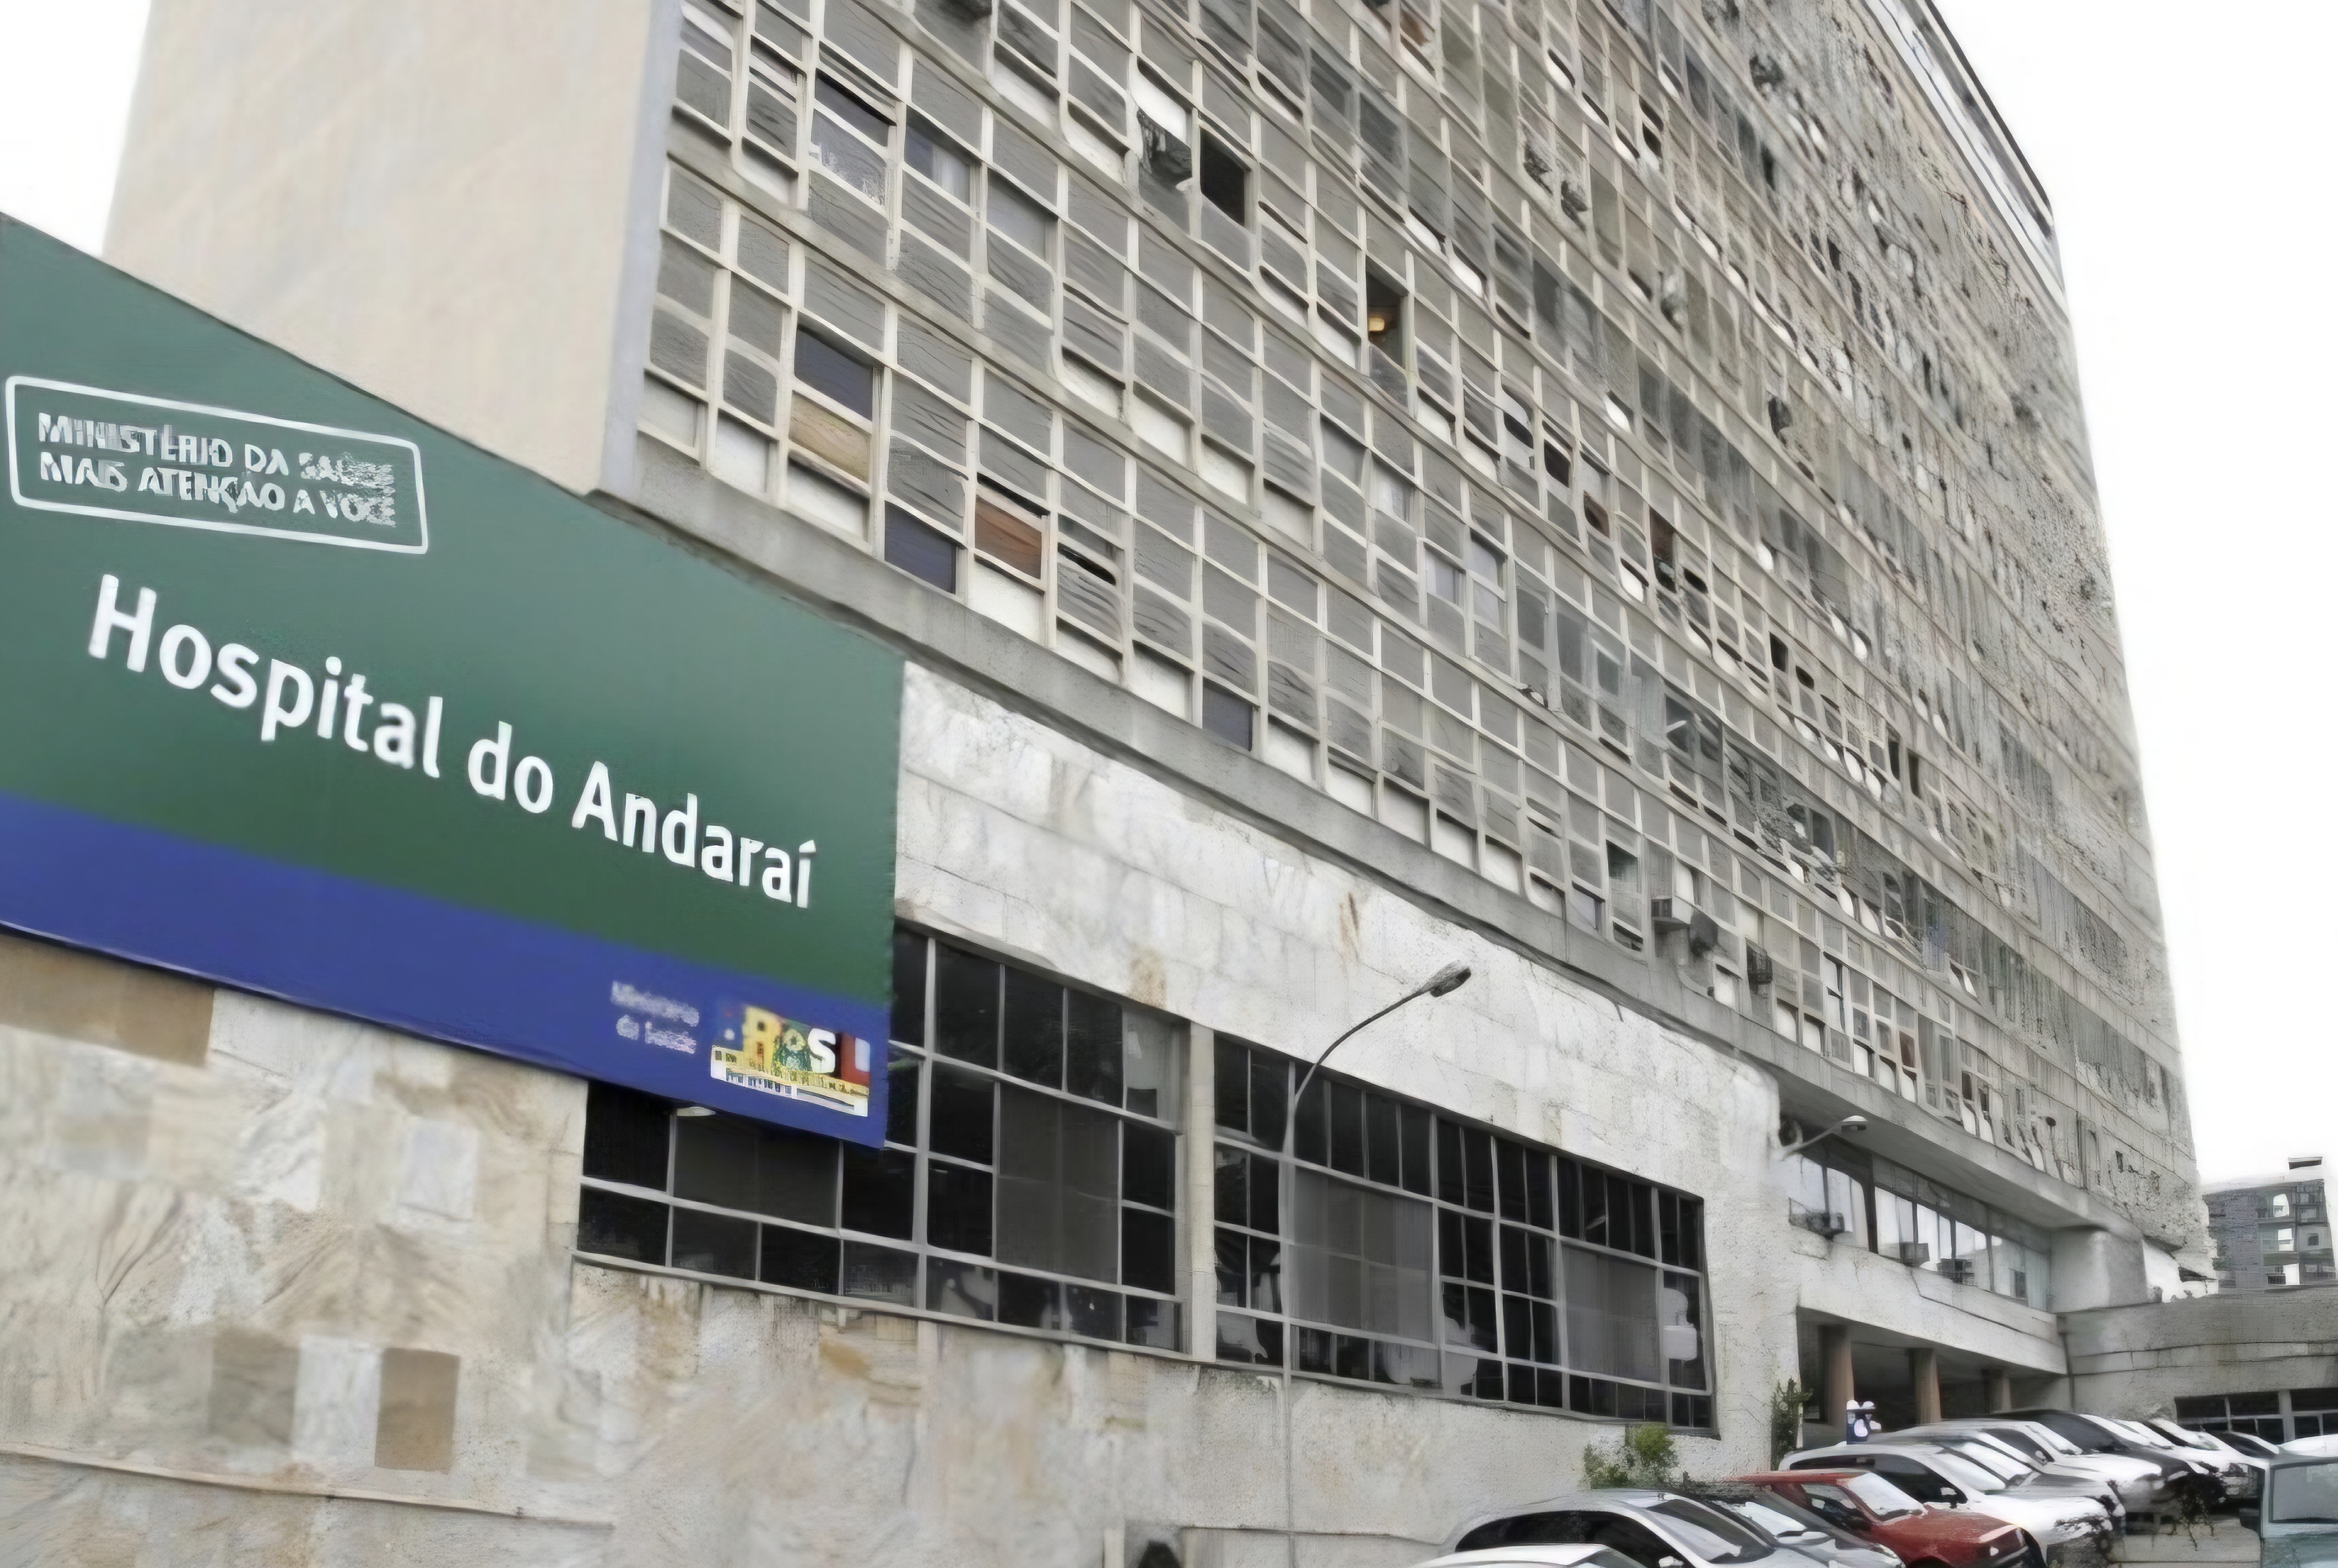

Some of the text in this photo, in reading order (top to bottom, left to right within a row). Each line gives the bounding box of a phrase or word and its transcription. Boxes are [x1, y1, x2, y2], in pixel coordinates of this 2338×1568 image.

[244, 443, 289, 477] DA
[293, 488, 316, 515] A
[87, 573, 817, 909] Hospital do Andaraí
